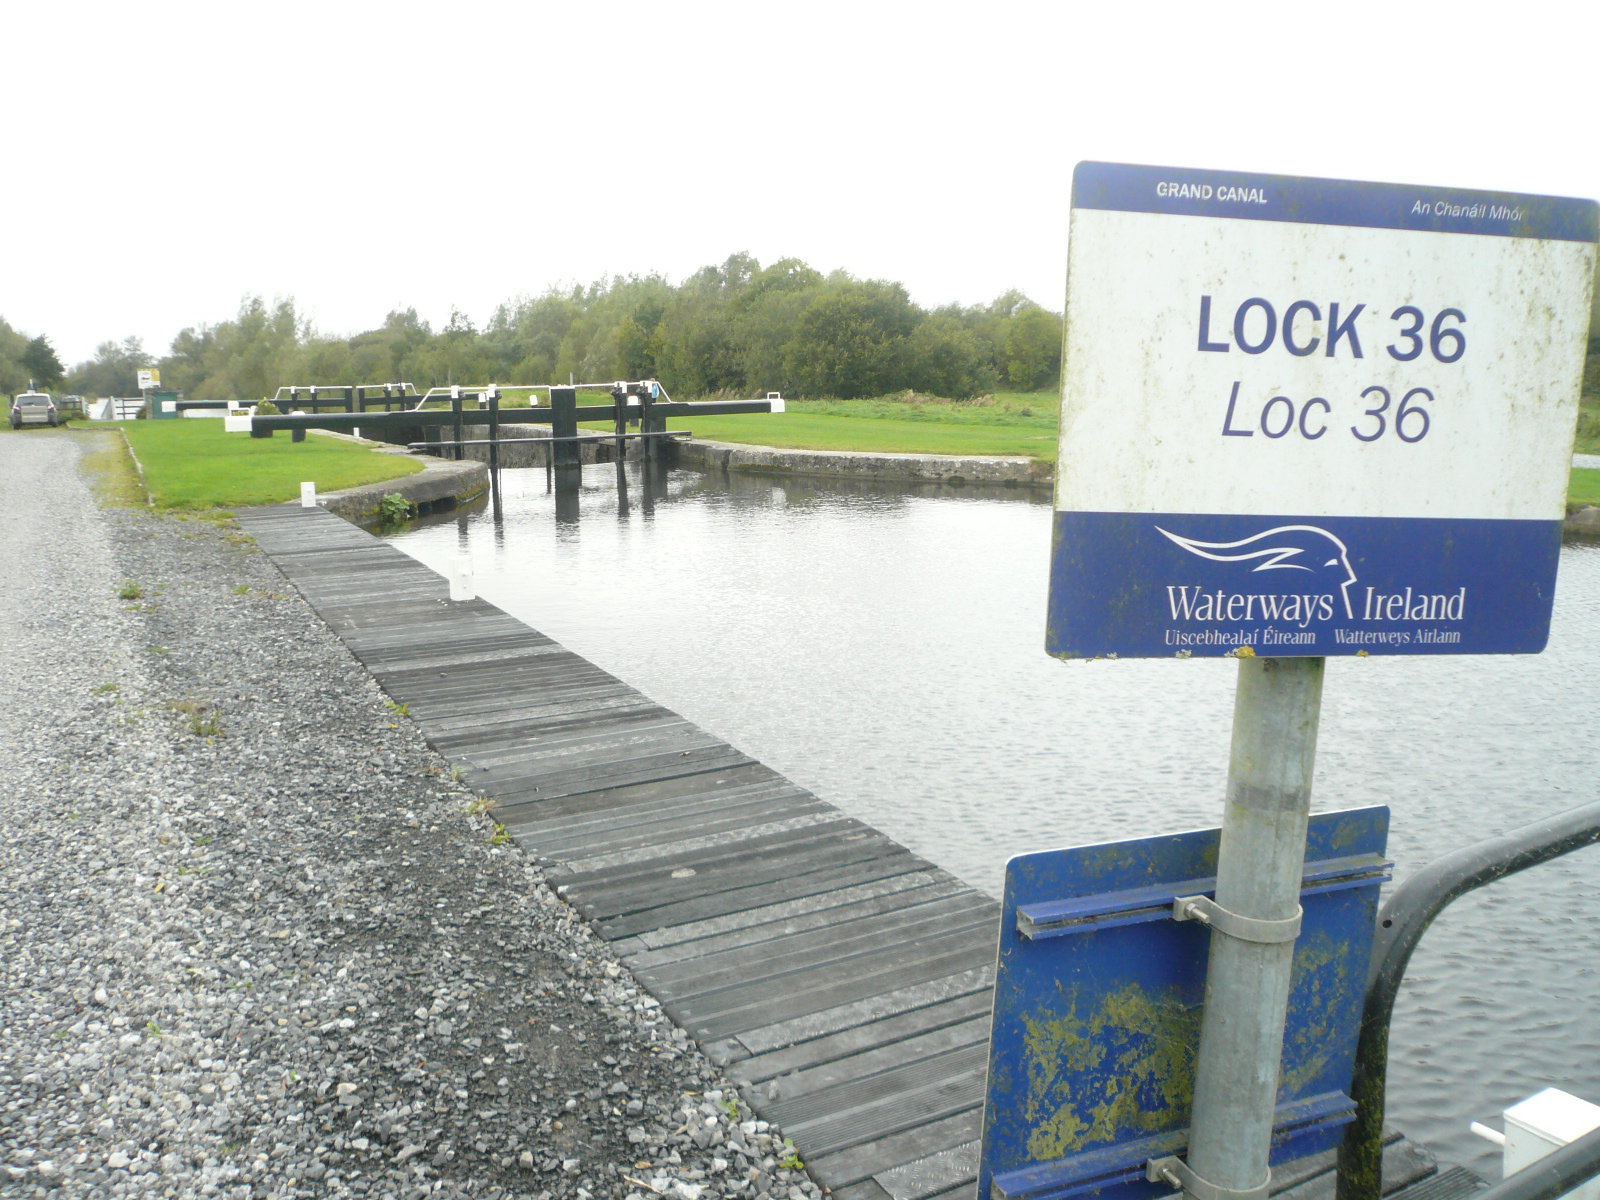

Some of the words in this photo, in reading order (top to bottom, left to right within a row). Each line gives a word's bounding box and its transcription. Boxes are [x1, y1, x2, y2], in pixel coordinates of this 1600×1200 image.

[1156, 181, 1213, 200] GRAND
[1217, 185, 1268, 204] CANAL
[1411, 199, 1431, 215] An
[1434, 201, 1487, 219] Chanáil
[1488, 204, 1525, 221] Mhór
[1197, 295, 1367, 359] LOCK
[1386, 305, 1467, 364] 36
[1221, 381, 1332, 441] Loc
[1350, 385, 1435, 444] 36
[1166, 585, 1334, 628] Waterways
[1362, 586, 1466, 620] Ireland
[1165, 628, 1259, 646] Uiscebhealaí
[1262, 625, 1316, 645] Éireann
[1334, 628, 1411, 647] Watterweys
[1412, 628, 1461, 644] Airlann
